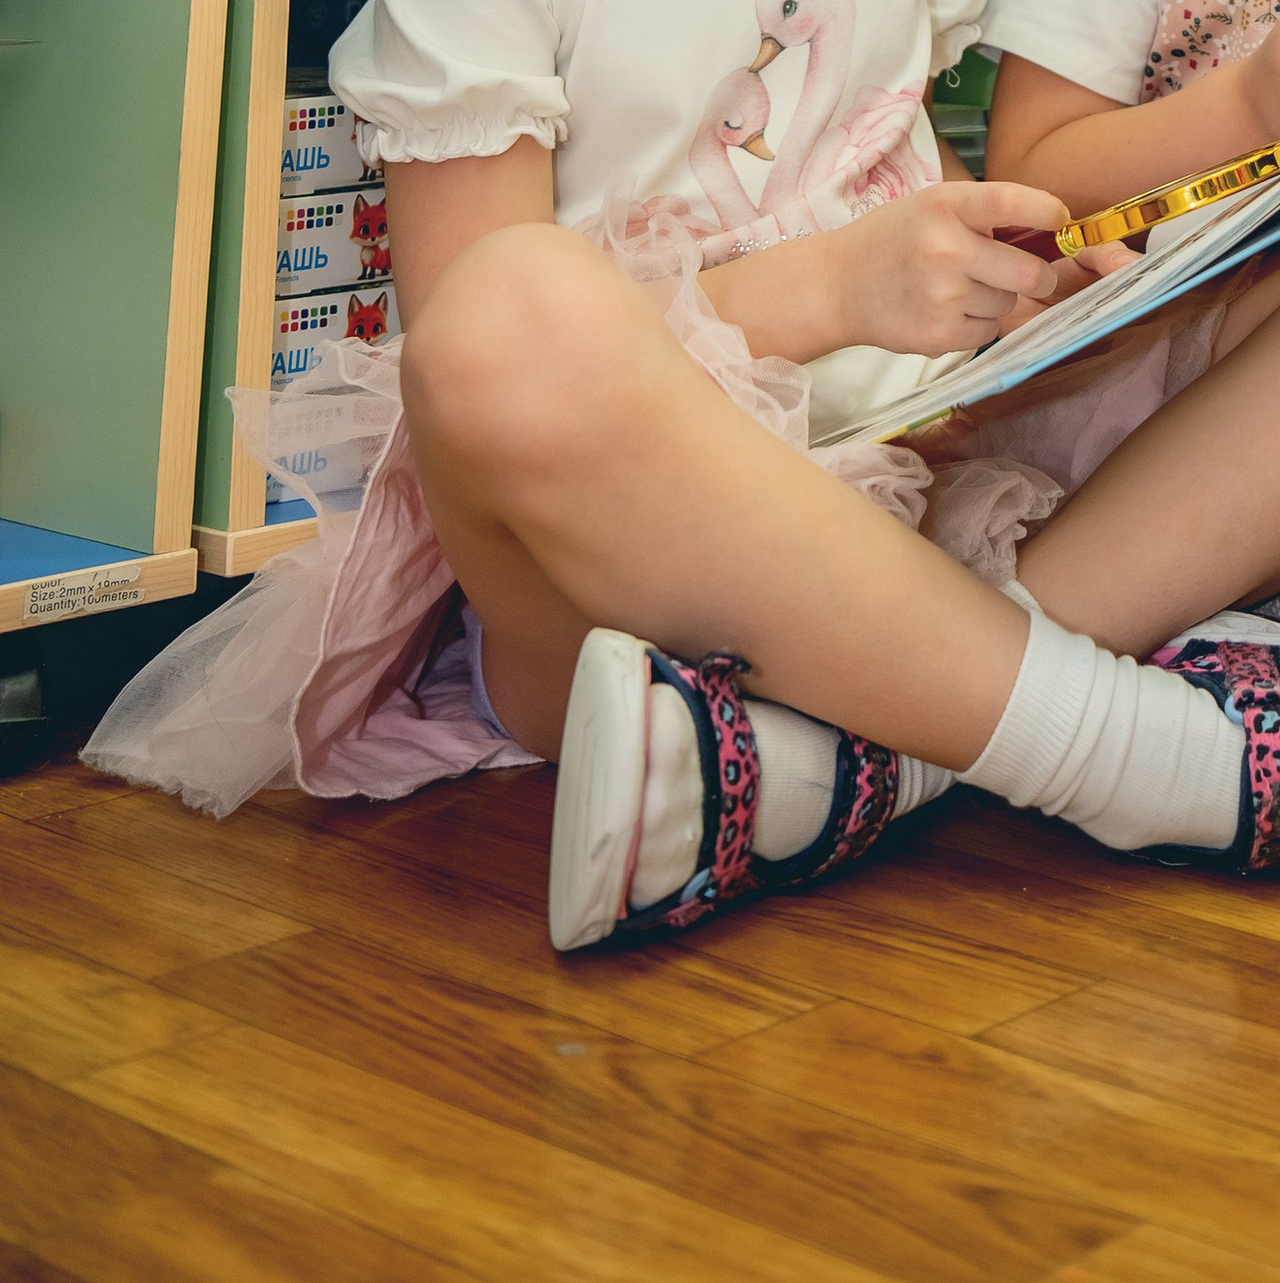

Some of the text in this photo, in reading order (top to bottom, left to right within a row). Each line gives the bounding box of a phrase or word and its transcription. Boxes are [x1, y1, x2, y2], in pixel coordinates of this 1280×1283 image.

[281, 146, 330, 172] АШЬ
[276, 246, 329, 273] АШЬ
[271, 347, 323, 376] АШЬ
